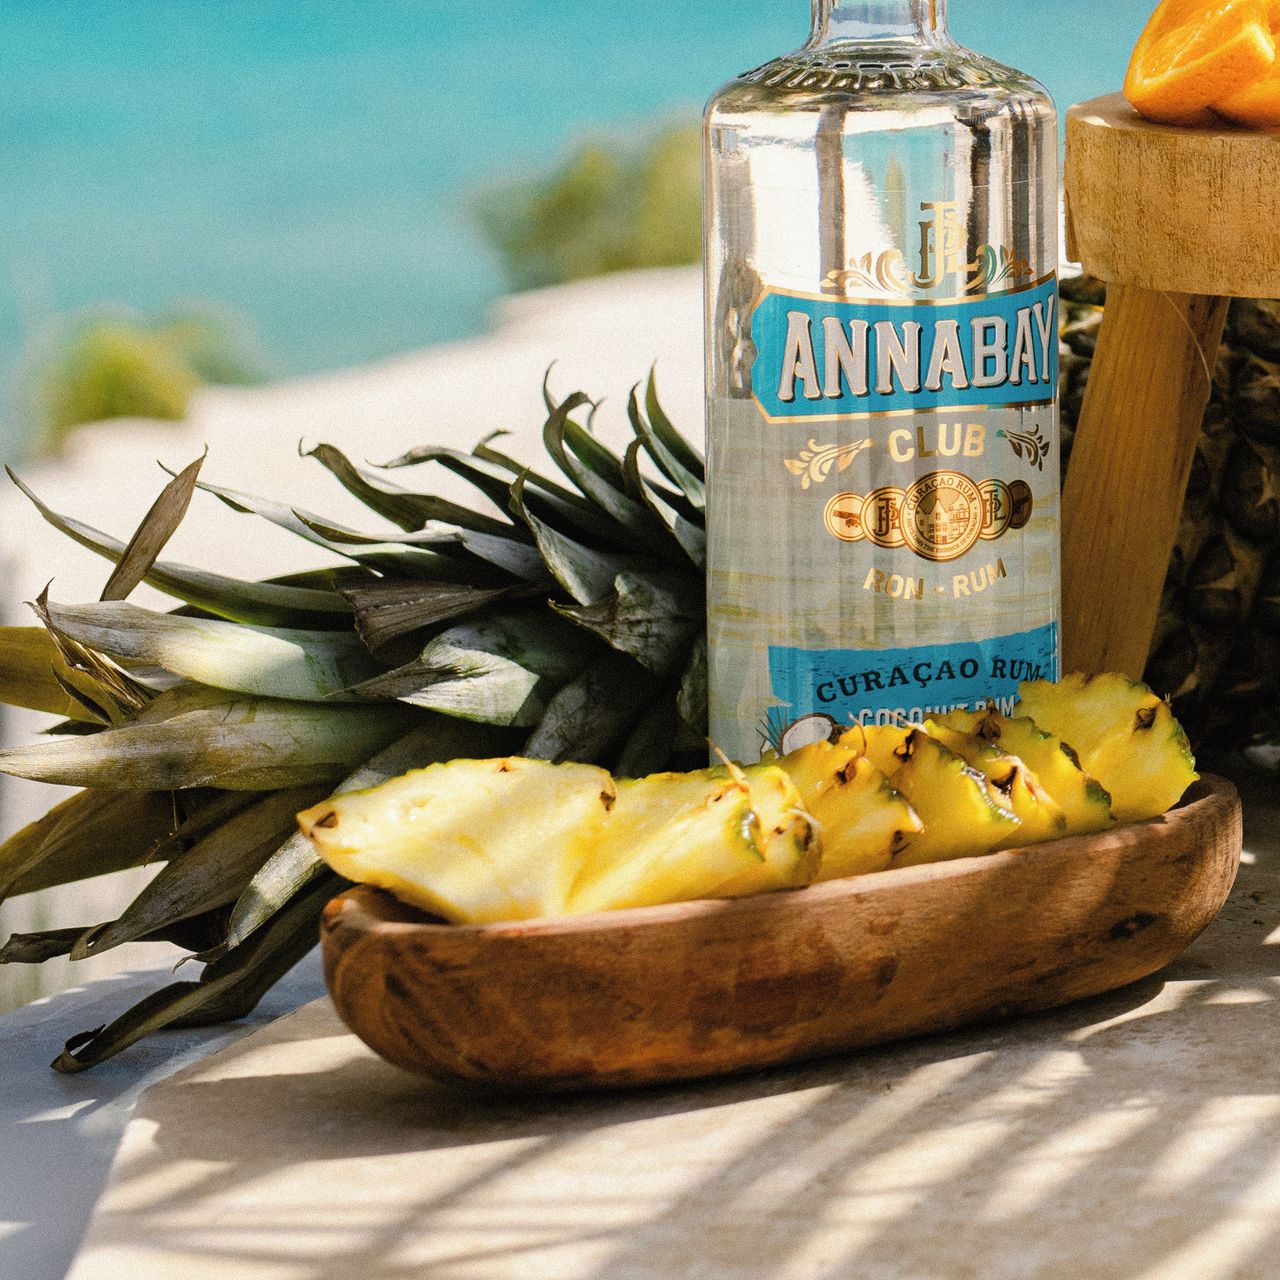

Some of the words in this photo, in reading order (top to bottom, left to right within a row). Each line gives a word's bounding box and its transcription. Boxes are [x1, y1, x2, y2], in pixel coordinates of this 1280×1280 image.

[778, 295, 1054, 402] ANNABAY
[888, 423, 987, 462] CLUB
[956, 480, 976, 503] RUM
[863, 567, 924, 601] RON
[953, 557, 1007, 599] RUM
[817, 659, 979, 703] CURAÇAO
[991, 659, 1042, 681] RUM
